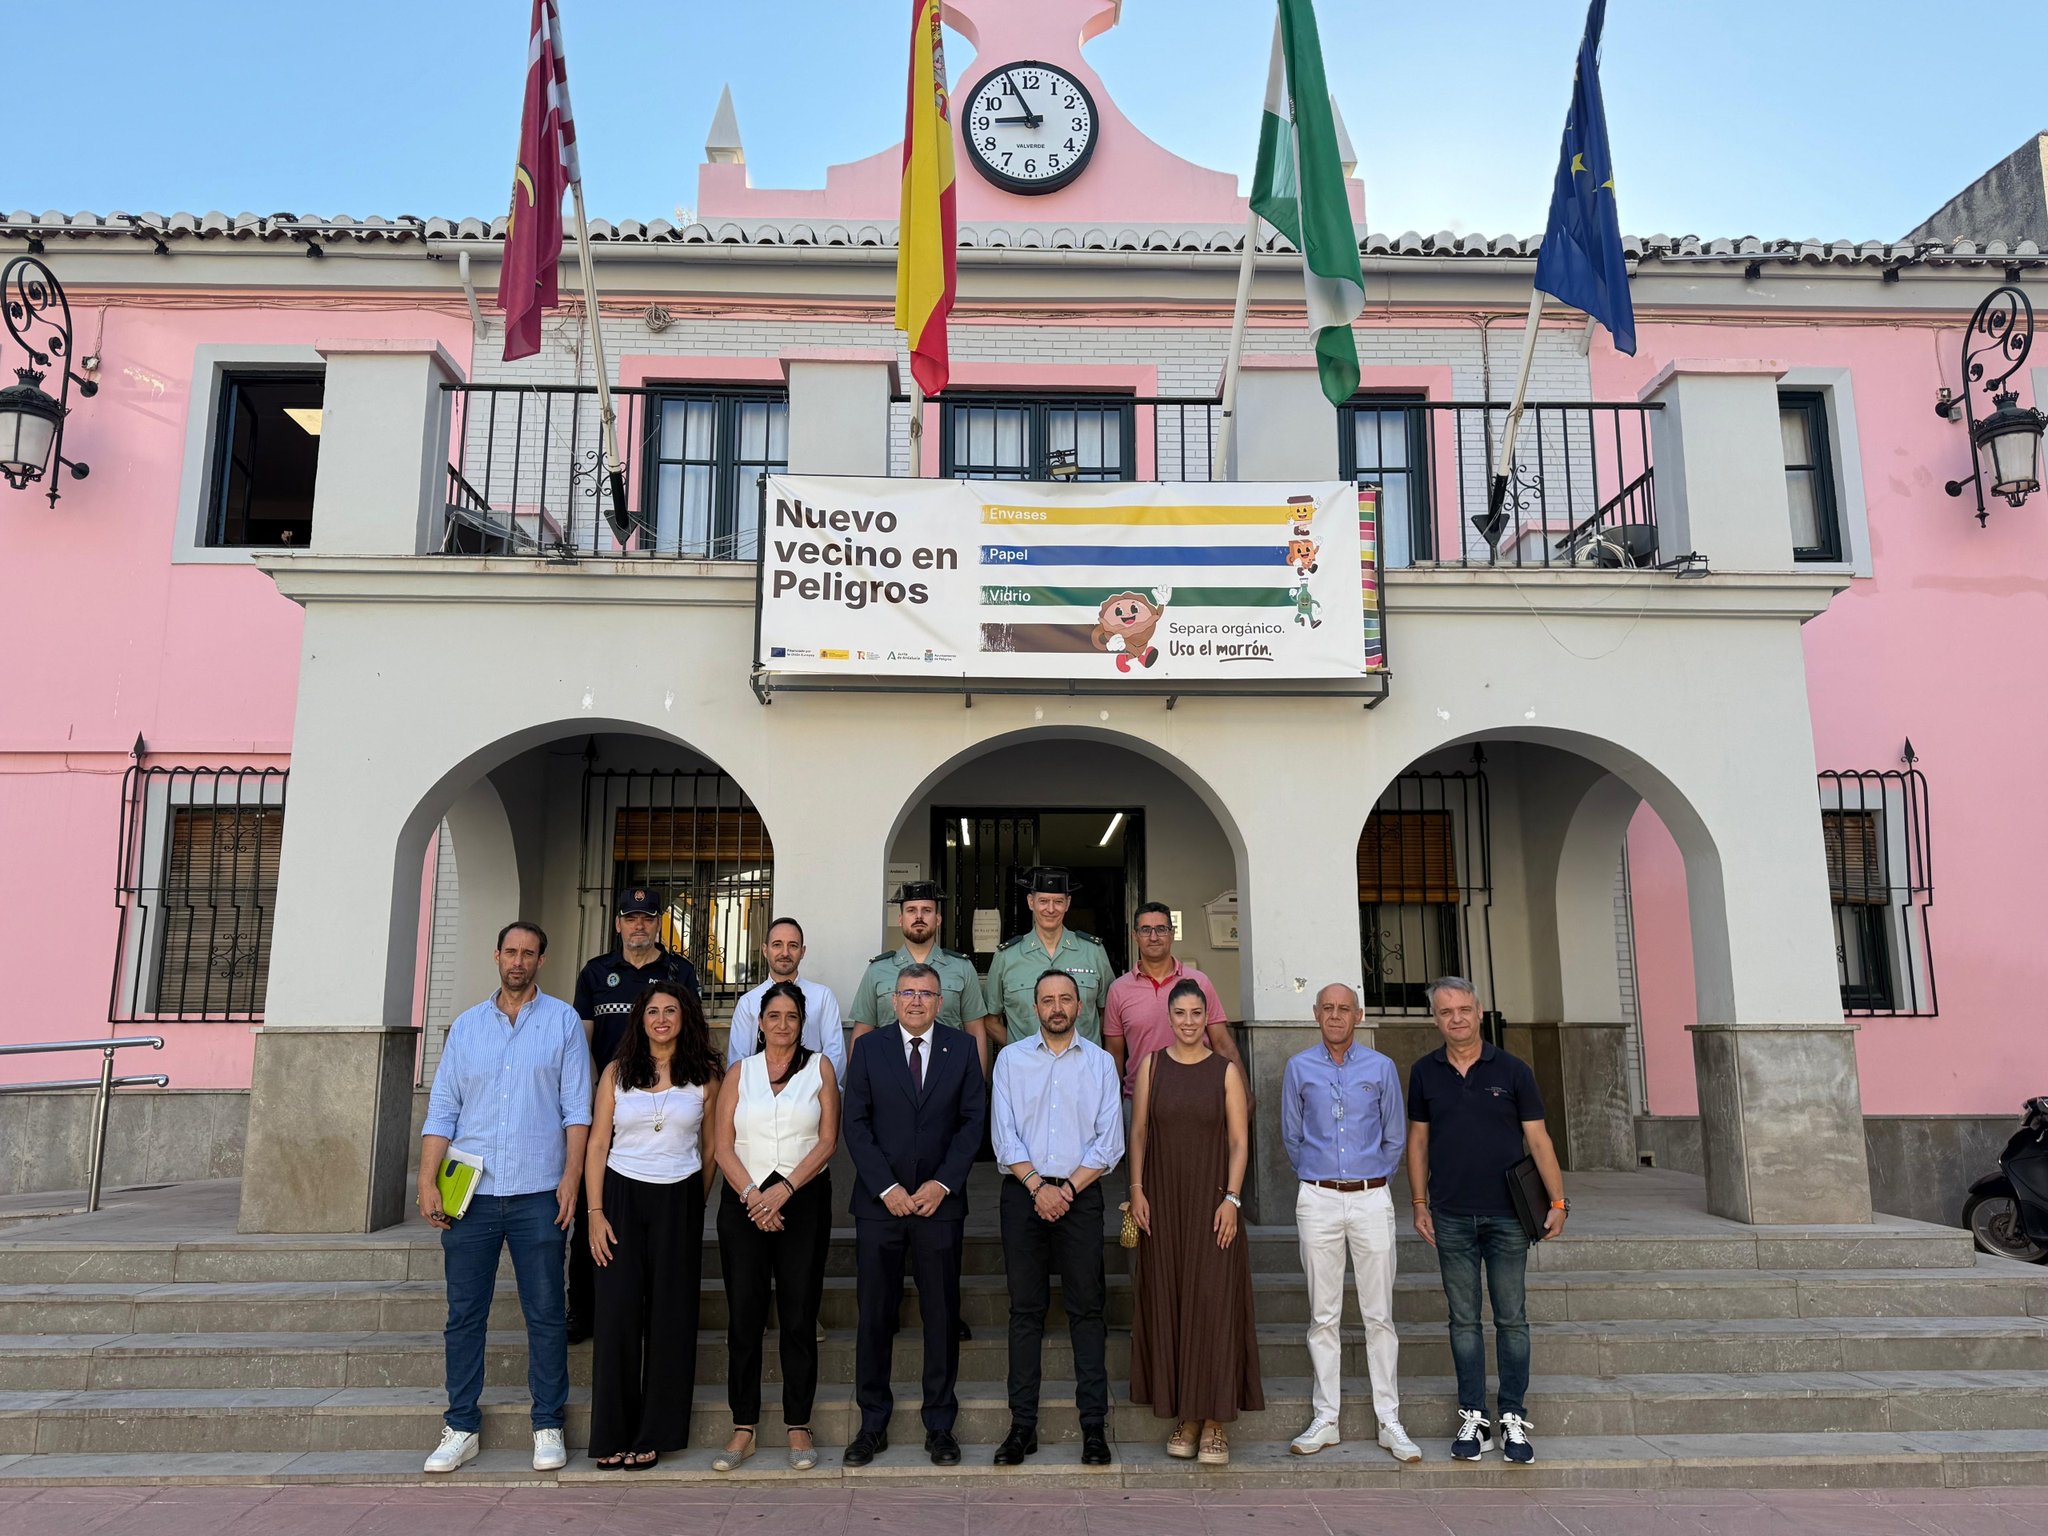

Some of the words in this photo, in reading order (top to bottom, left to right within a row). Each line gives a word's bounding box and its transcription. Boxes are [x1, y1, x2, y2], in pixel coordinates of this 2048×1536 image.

[1022, 75, 1040, 90] 12
[1050, 81, 1058, 96] 1
[985, 97, 1002, 111] 10
[1064, 95, 1075, 110] 2
[978, 116, 990, 131] 9
[1071, 117, 1083, 132] 3
[984, 136, 997, 151] 8
[1063, 137, 1075, 152] 4
[1001, 152, 1013, 167] 7
[1024, 159, 1036, 173] 6
[1048, 153, 1059, 168] 5
[776, 499, 897, 533] Nuevo
[990, 508, 1047, 520] Envases
[774, 537, 902, 568] vecino
[912, 547, 958, 570] en
[989, 548, 1028, 563] Papel
[773, 569, 929, 610] Peligros
[989, 588, 1031, 602] Vidrio
[1169, 622, 1218, 637] Separa
[1221, 622, 1285, 637] orgánico.
[1169, 640, 1195, 656] Usa
[1200, 640, 1211, 656] el
[1216, 640, 1272, 656] marrón.
